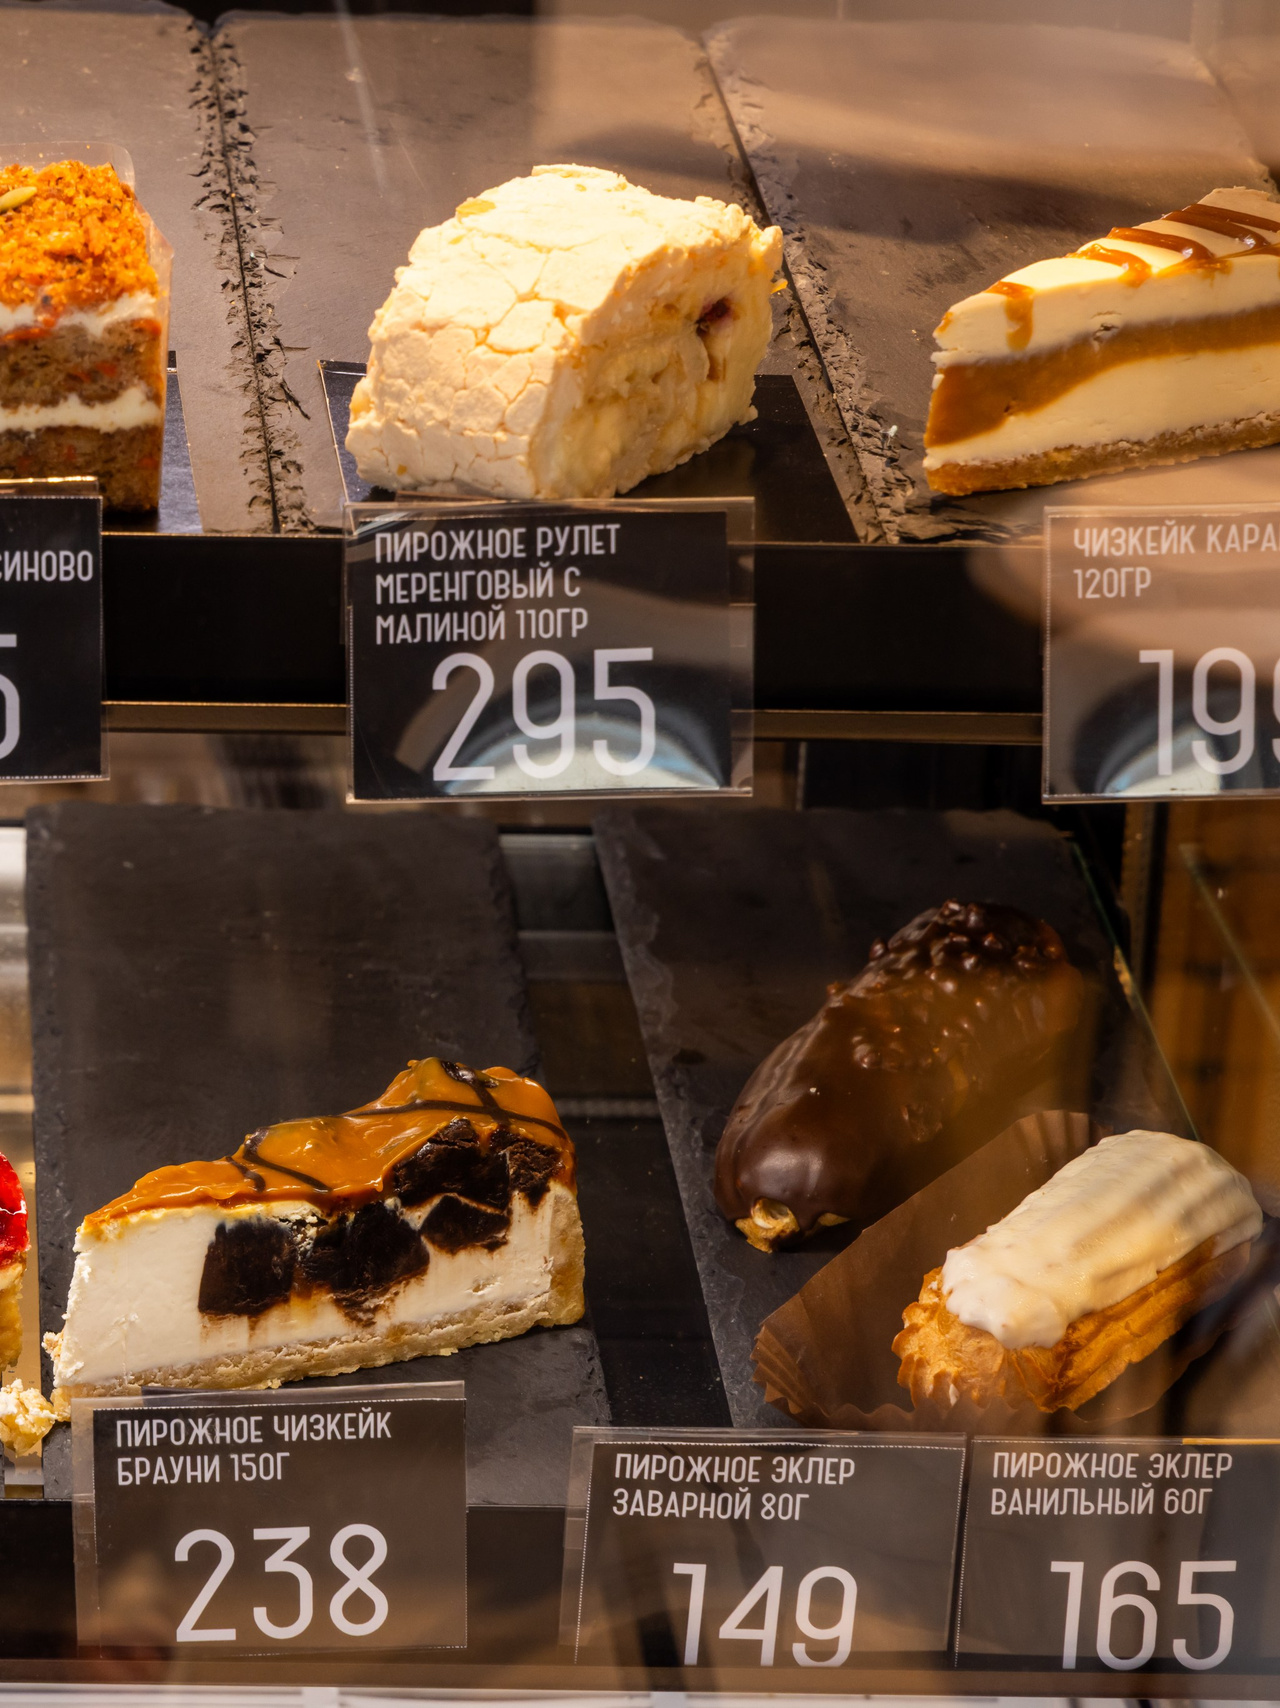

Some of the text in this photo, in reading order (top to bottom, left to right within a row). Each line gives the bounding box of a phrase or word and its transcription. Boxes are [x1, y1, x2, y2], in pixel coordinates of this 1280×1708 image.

[375, 523, 621, 564] ПИРОЖНОЕ РУЛЕТ
[1073, 520, 1280, 557] ЧИЗКЕЙК КАРА
[375, 562, 581, 605] МЕРЕНГОВЫЙ С
[1073, 566, 1152, 599] 120ГР
[375, 605, 588, 645] МАЛИНОЙ 110ГР
[432, 646, 656, 782] 295
[1138, 646, 1280, 776] 19
[116, 1407, 392, 1448] ПИРОЖНОЕ ЧИЗКЕЙК
[117, 1452, 290, 1486] БРАУНИ 150Г
[614, 1453, 856, 1486] ПИРОЖНОЕ ЭКЛЕР
[992, 1452, 1234, 1479] ПИРОЖНОЕ ЭКЛЕР
[612, 1487, 810, 1521] ЗАВАРНОЙ 80Г
[990, 1482, 1214, 1516] ВАНИЛЬНЫЙ 60Г
[174, 1523, 389, 1642] 238
[673, 1562, 858, 1667] 149
[1050, 1560, 1238, 1671] 165
